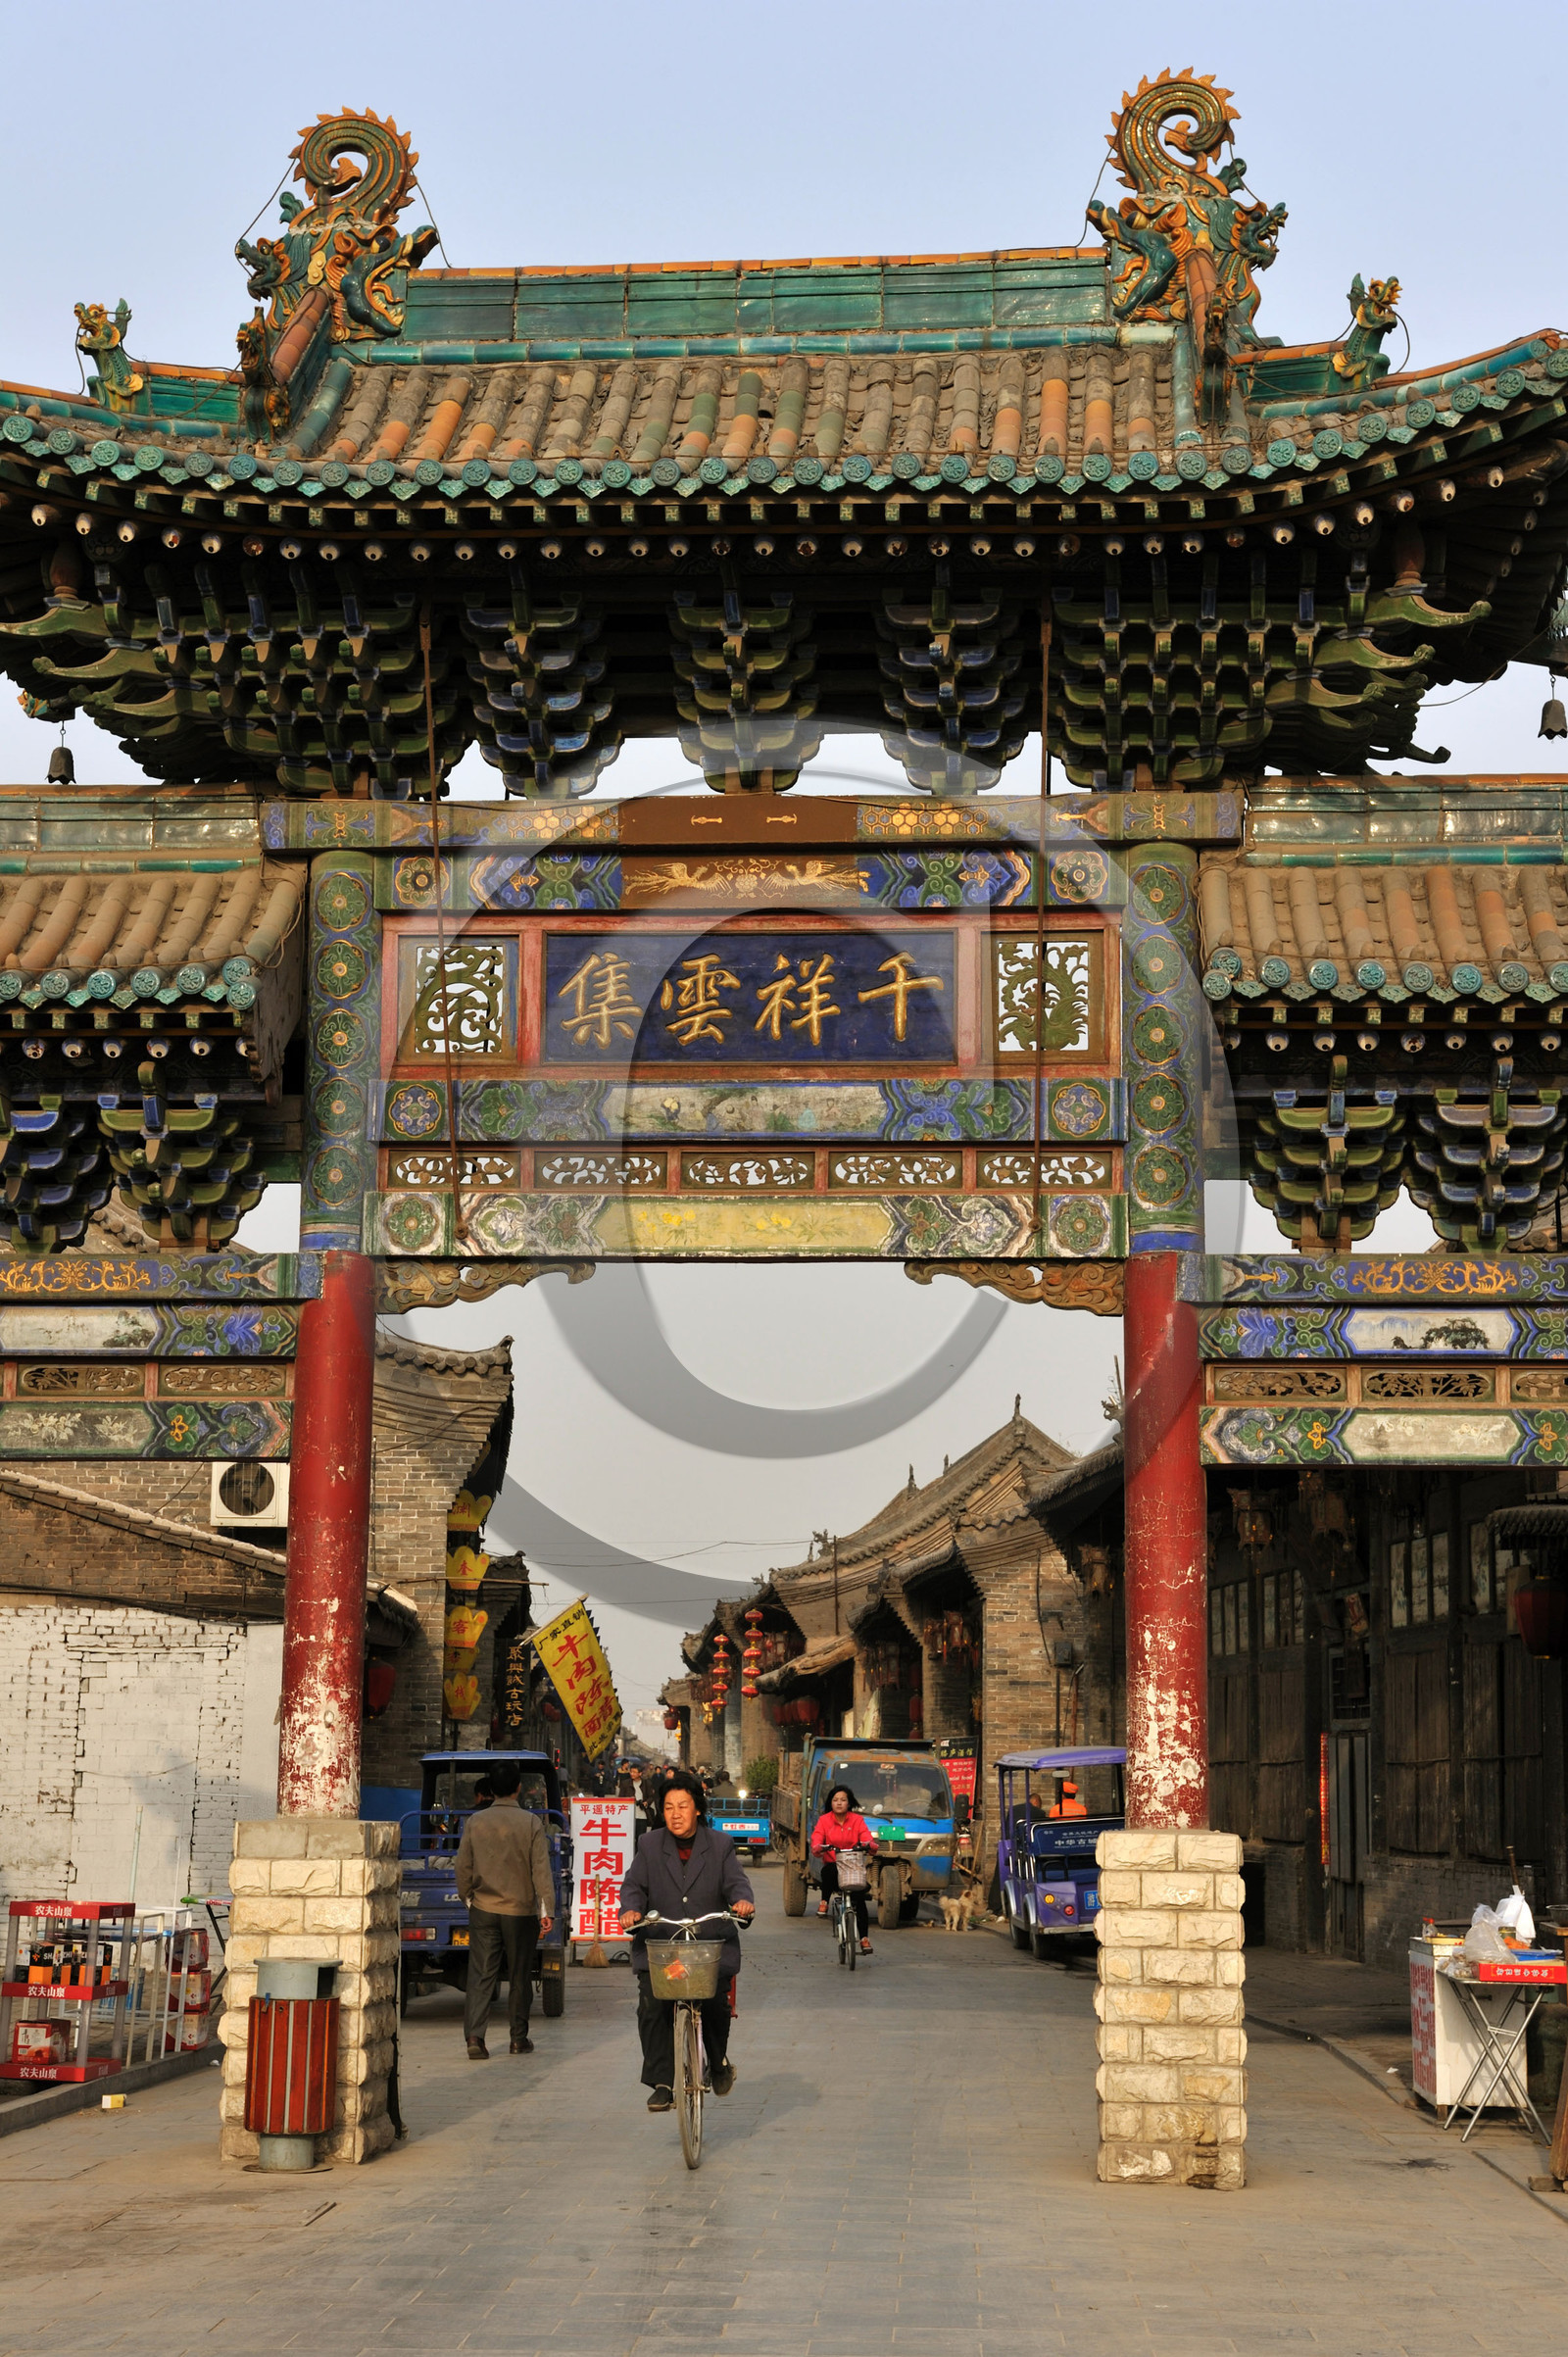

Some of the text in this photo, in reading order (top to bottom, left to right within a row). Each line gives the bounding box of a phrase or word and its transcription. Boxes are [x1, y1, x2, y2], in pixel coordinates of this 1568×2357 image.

[538, 1608, 585, 1650] 厂家直销
[552, 1633, 615, 1738] 牛肉陈醋
[579, 1804, 629, 1815] 平遥特产
[579, 1817, 627, 1936] 牛肉陈醋
[34, 1905, 74, 1917] 农夫山泉
[27, 1986, 66, 1997] 农夫山泉
[20, 2067, 59, 2079] 农夫山泉
